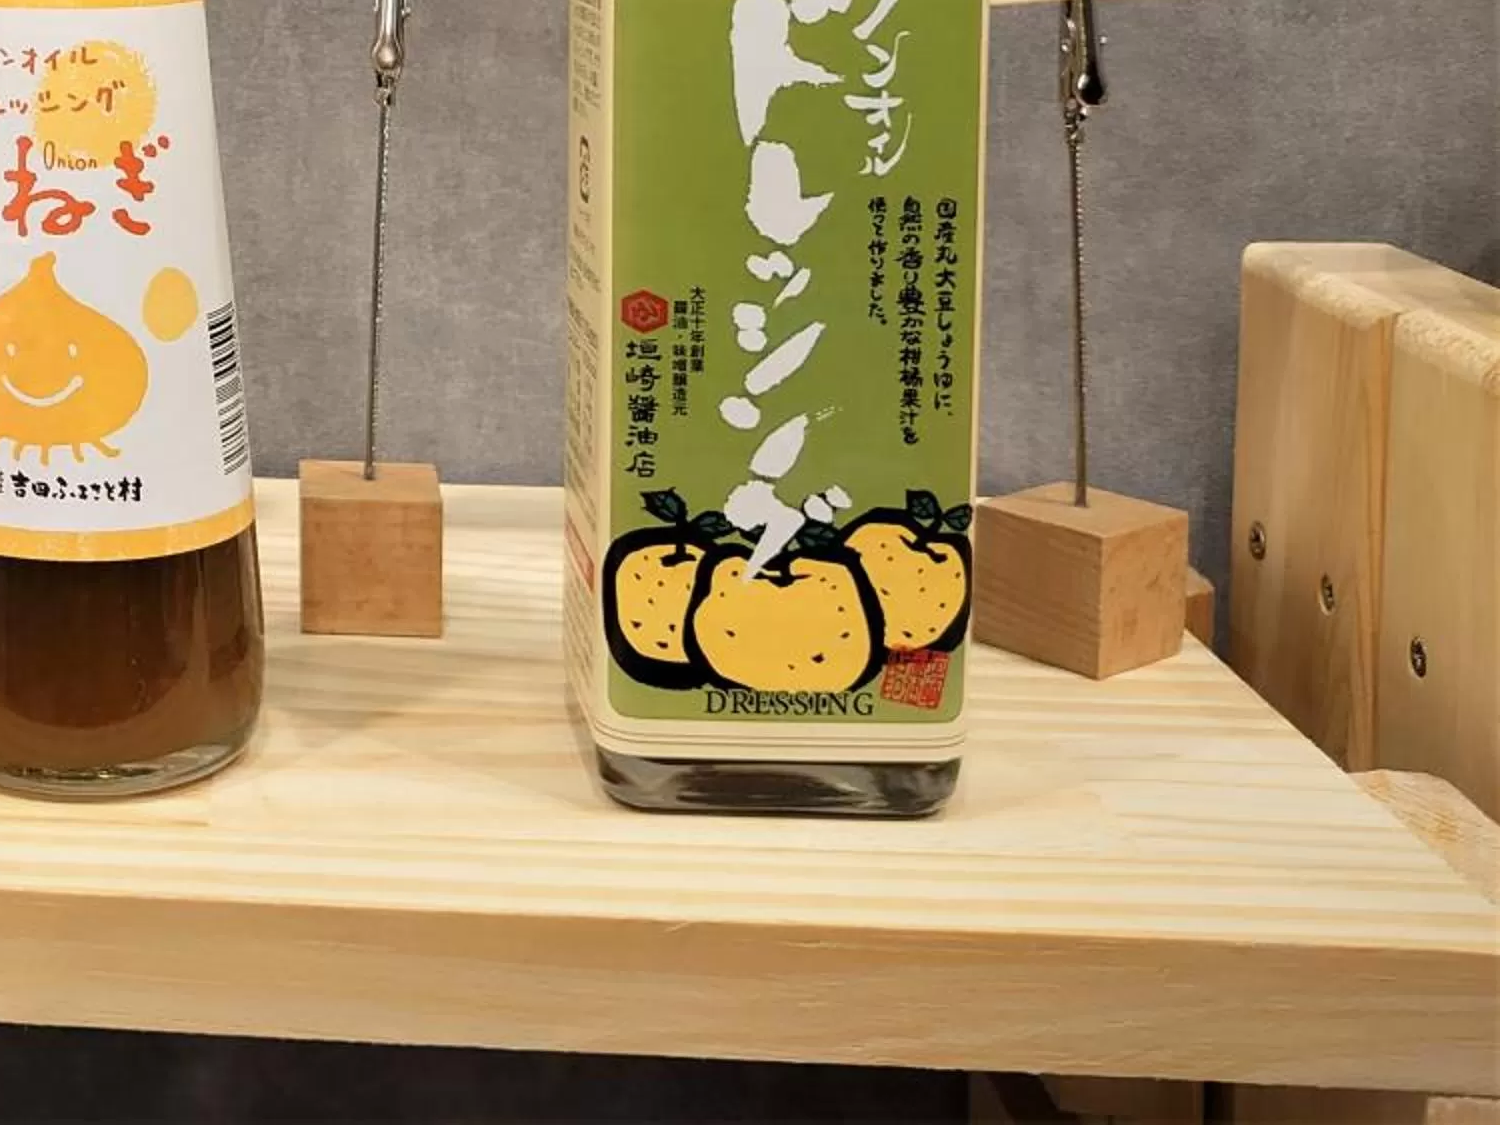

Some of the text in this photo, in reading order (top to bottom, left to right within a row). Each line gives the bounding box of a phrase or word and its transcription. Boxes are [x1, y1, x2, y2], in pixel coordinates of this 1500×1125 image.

[43, 141, 97, 170] Onion
[10, 471, 143, 501] 吉田ふるさと村
[705, 689, 874, 716] DRESSING
